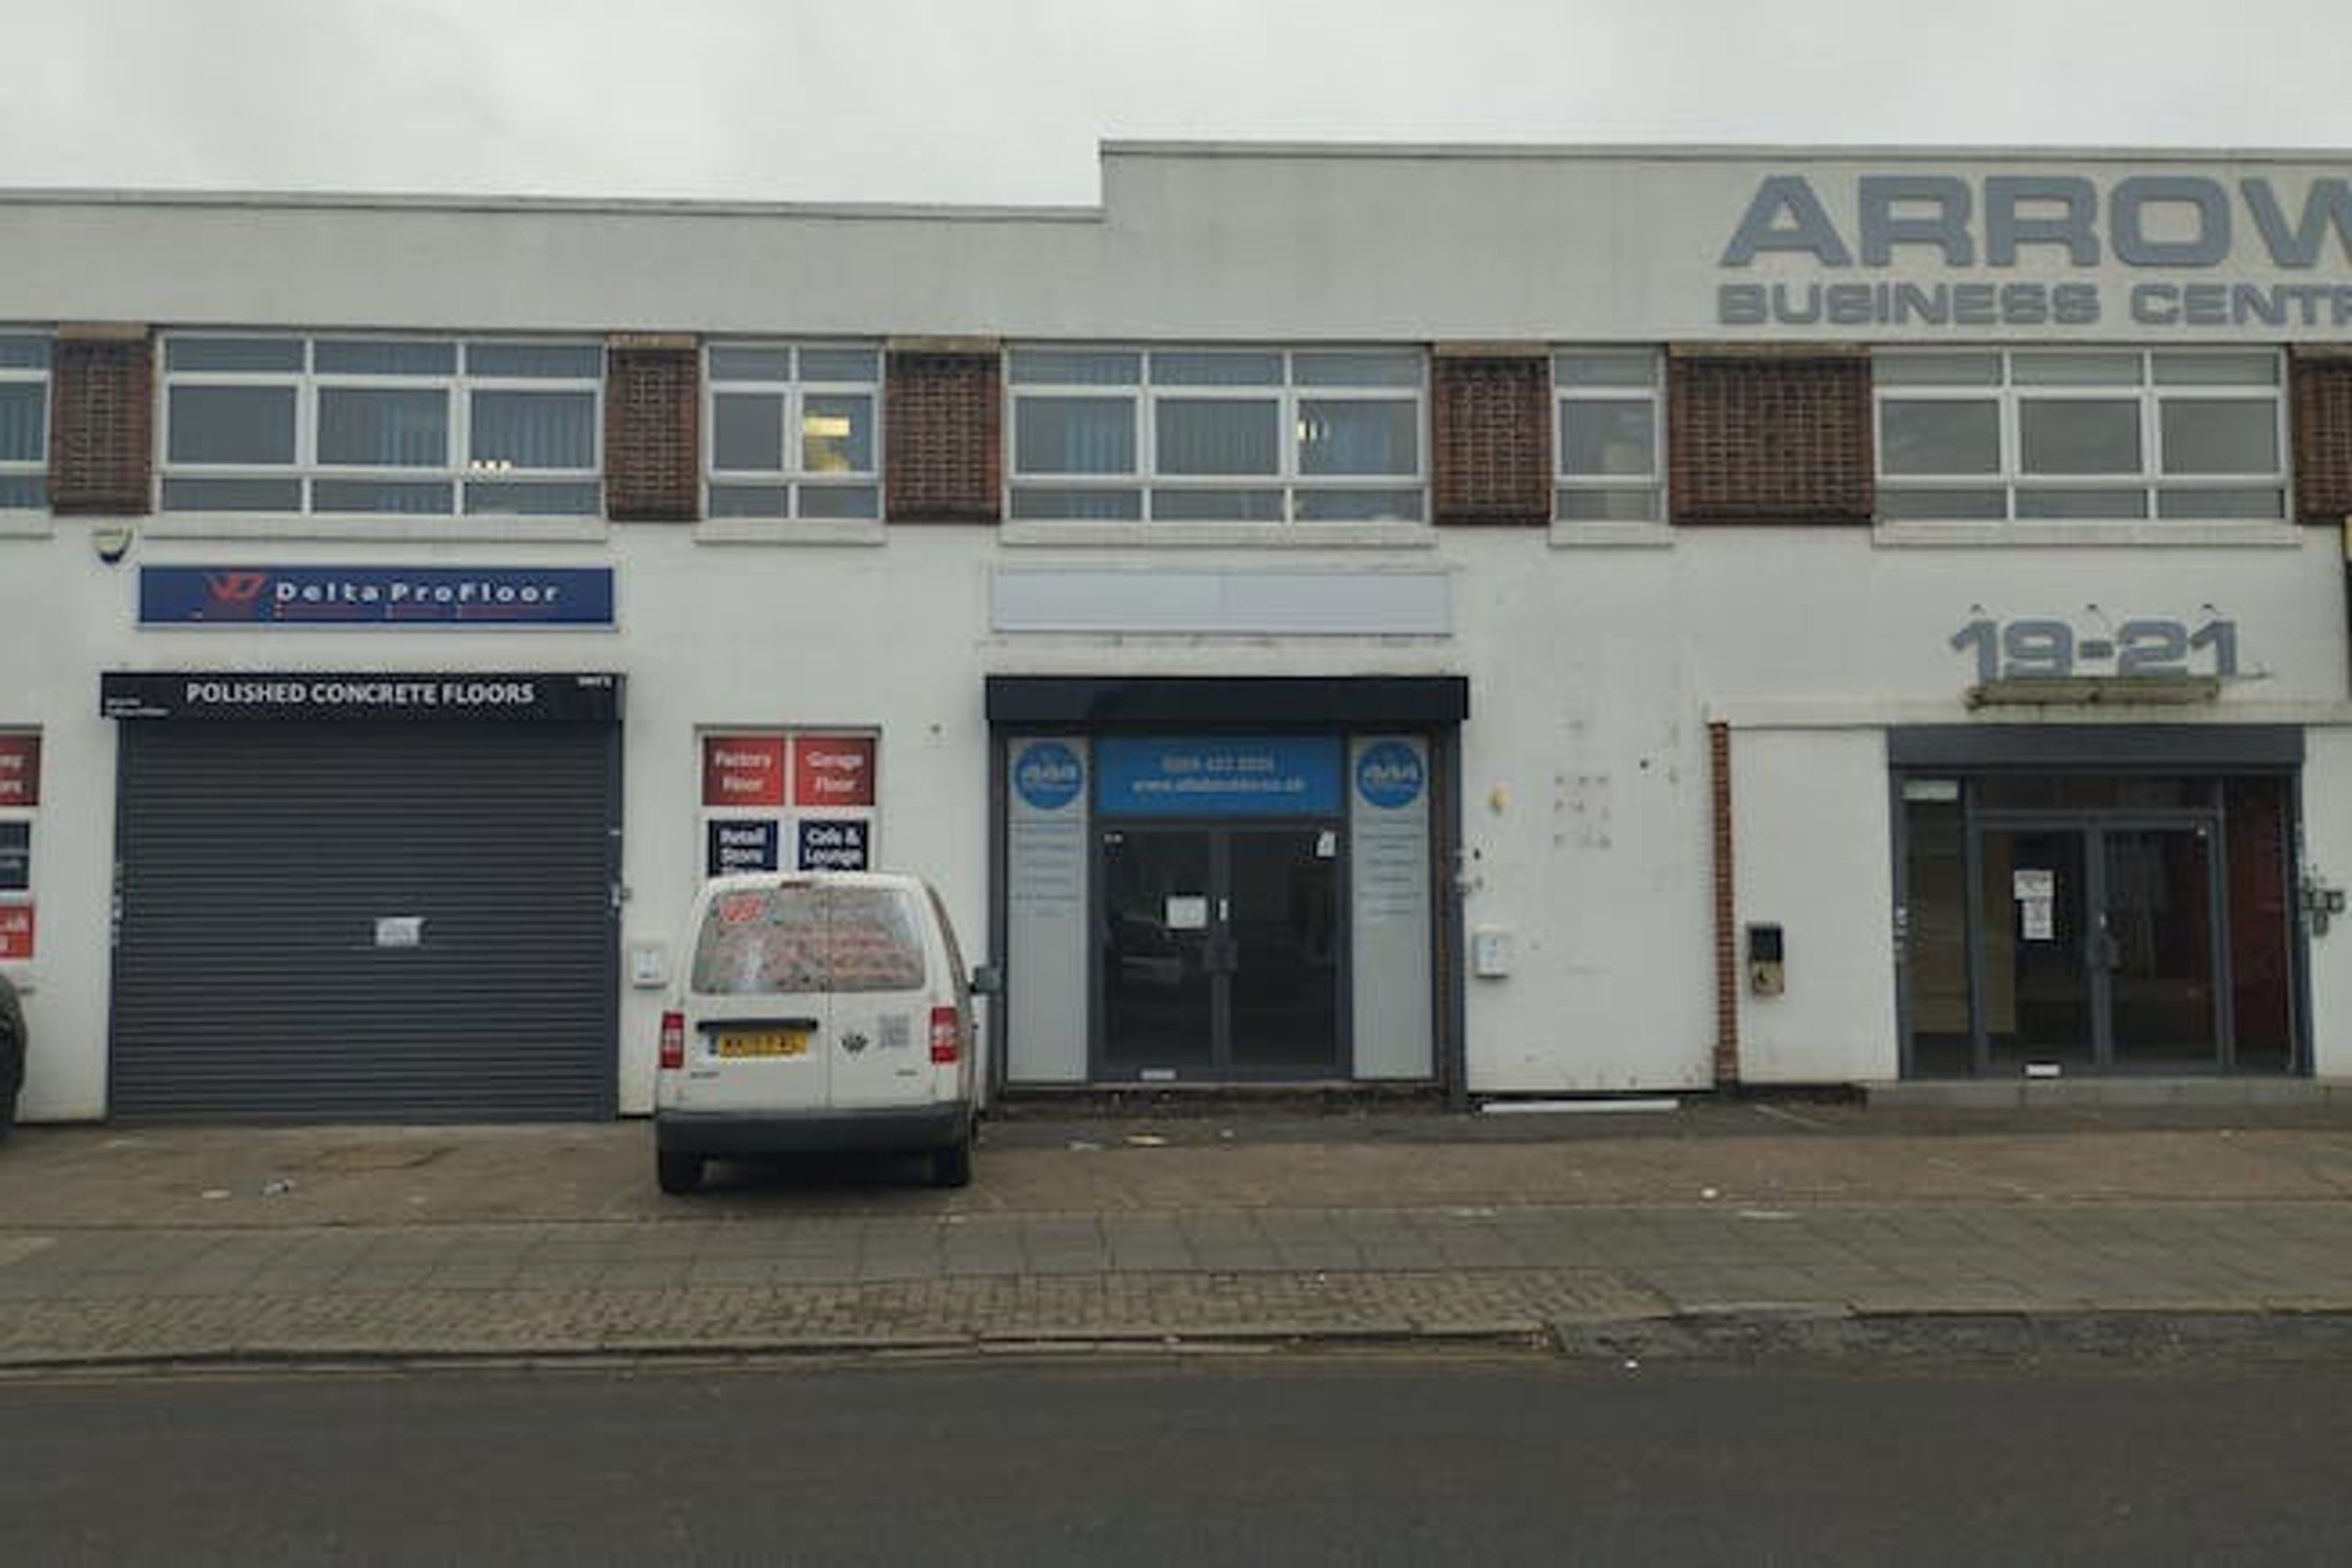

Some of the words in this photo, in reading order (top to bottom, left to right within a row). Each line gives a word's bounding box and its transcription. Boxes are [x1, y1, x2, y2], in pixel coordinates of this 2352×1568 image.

[1719, 175, 2352, 268] ARROW
[1718, 283, 2102, 325] BUSINESS
[277, 581, 379, 602] Delta
[390, 581, 560, 603] ProFloor
[1950, 621, 2237, 686] 19-21
[187, 682, 306, 703] POLISHED
[311, 682, 436, 704] CONCRETE
[442, 683, 534, 704] FLOORS
[715, 751, 772, 769] Factory
[719, 828, 766, 845] Retail
[804, 849, 864, 867] Lounge
